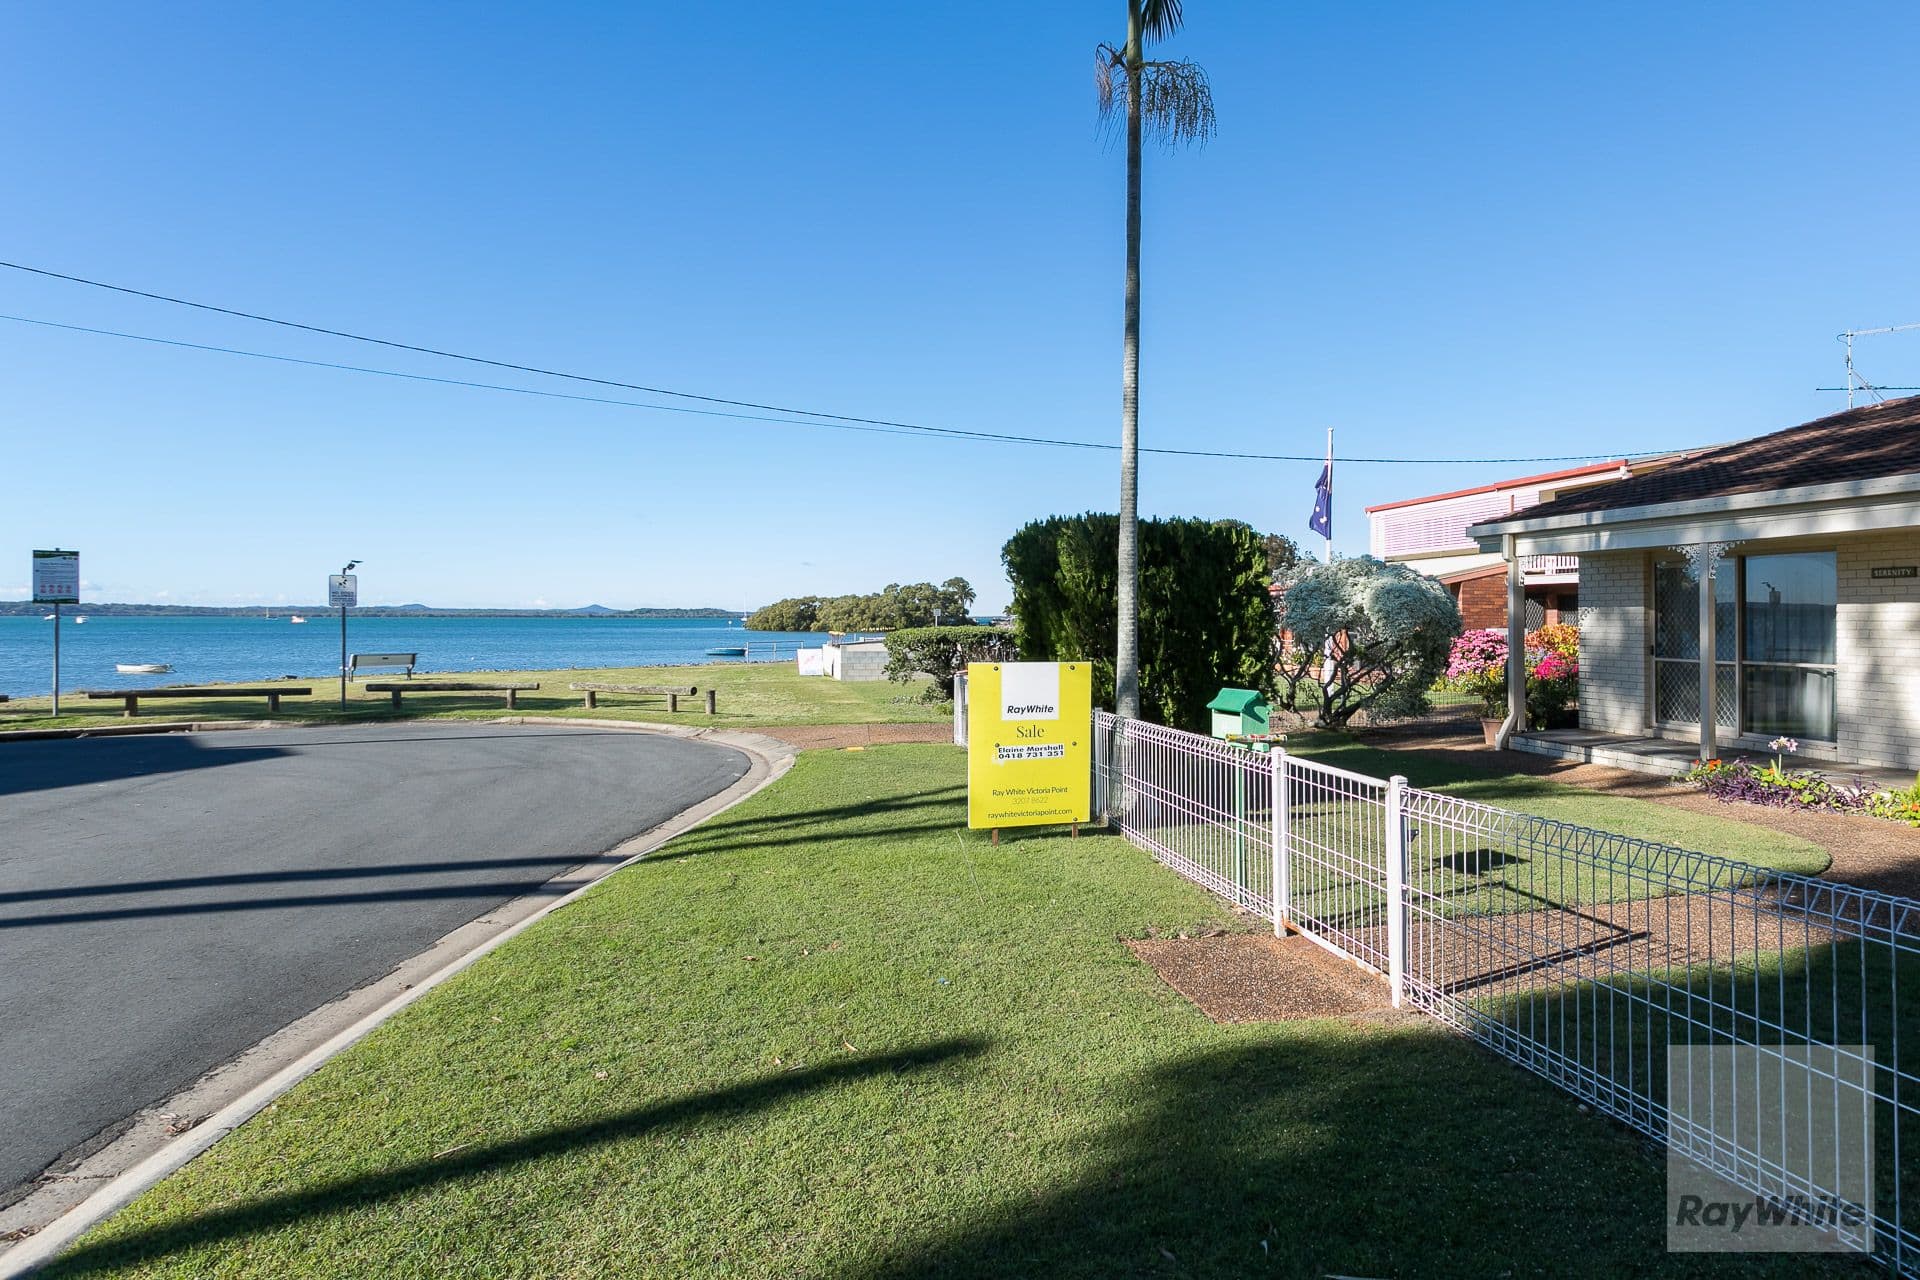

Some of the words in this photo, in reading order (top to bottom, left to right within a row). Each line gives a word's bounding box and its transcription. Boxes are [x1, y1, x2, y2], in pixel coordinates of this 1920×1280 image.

[1007, 705, 1054, 715] RayWhite
[1016, 725, 1045, 738] Sale
[992, 789, 1004, 797] Ray
[1005, 788, 1026, 796] White
[1027, 787, 1051, 795] Victoria
[987, 809, 1073, 818] raywhitevictoriapoint.com
